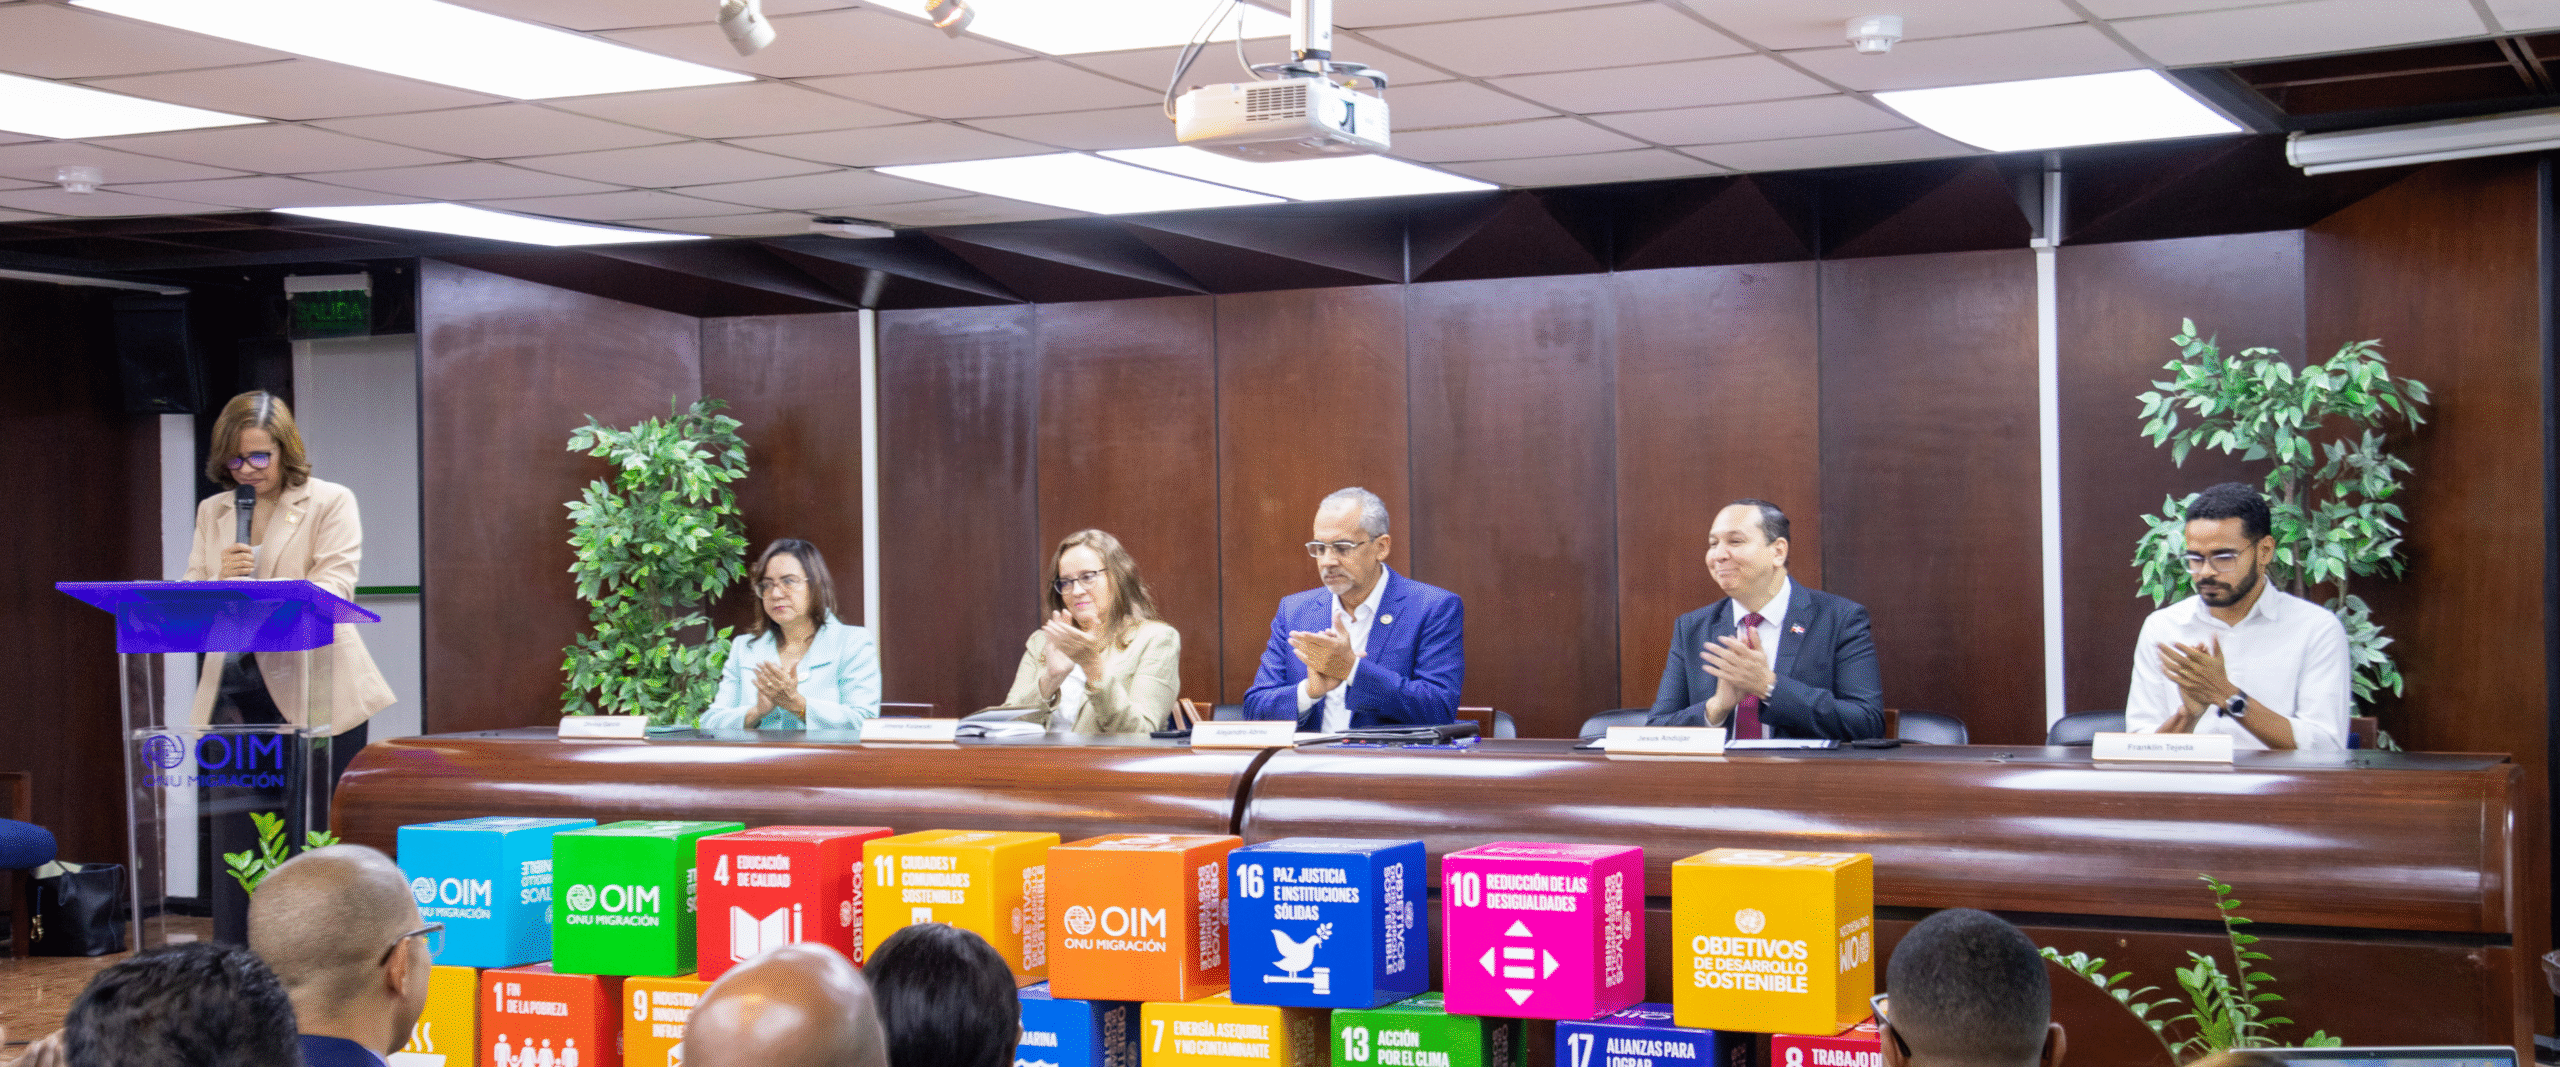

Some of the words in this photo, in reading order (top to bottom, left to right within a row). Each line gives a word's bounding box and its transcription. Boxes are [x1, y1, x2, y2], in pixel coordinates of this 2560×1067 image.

[195, 734, 282, 770] OIM
[2166, 743, 2194, 752] Tejeda
[143, 774, 181, 787] ONU
[187, 771, 284, 788] MIGRACIÓN
[713, 854, 730, 886] 4
[737, 854, 790, 870] EDUCACIÓN
[873, 855, 894, 887] 11
[901, 855, 949, 870] CIUDADES
[950, 856, 957, 871] Y
[737, 872, 750, 887] DE
[750, 872, 791, 888] CALIDAD
[901, 872, 970, 888] COMUNIDADES
[1236, 863, 1264, 898] 16
[1298, 868, 1347, 884] JUSTICIA
[1486, 872, 1549, 891] REDUCCIÓN
[1549, 876, 1564, 892] DE
[1565, 876, 1588, 893] LAS
[439, 877, 492, 907] OIM
[600, 884, 660, 913] OIM
[902, 888, 965, 904] SOSTENIBLES
[1273, 886, 1281, 901] E
[1281, 886, 1360, 903] INSTITUCIONES
[1451, 871, 1480, 908] 10
[418, 906, 435, 918] NU
[435, 906, 492, 920] MIGRACIÓN
[852, 861, 863, 963] OBJETIVOS
[1274, 902, 1319, 921] SÓLIDAS
[1486, 893, 1577, 912] DESIGUALDADES
[566, 914, 594, 925] ONU
[595, 913, 660, 927] MIGRACIÓN
[1022, 866, 1031, 971] OBJETIVOS
[1100, 905, 1166, 938] OIM
[1210, 861, 1221, 968] OBJETIVOS
[1395, 862, 1406, 972] OBJETIVOS
[1615, 871, 1624, 984] OBJETIVOS
[1064, 937, 1094, 950] ONU
[1095, 938, 1166, 953] MIGRACIÓN
[1692, 935, 1808, 960] OBJETIVOS
[1694, 956, 1713, 970] DE
[1715, 957, 1808, 975] DESARROLLO
[506, 982, 521, 997] FIN
[1694, 971, 1808, 993] SOSTENIBLE
[493, 982, 503, 1012] 1
[633, 989, 648, 1021] 9
[506, 999, 518, 1014] DE
[530, 1000, 568, 1017] POBREZA
[1151, 1019, 1165, 1053] 7
[1173, 1020, 1215, 1037] ENERGÍA
[1216, 1023, 1269, 1040] ASEQUIBLE
[1377, 1029, 1420, 1048] ACCIÓN
[1174, 1039, 1182, 1054] Y
[1182, 1039, 1196, 1055] NO
[1196, 1040, 1270, 1059] CONTAMINANTE
[1341, 1026, 1369, 1062] 13
[1567, 1033, 1595, 1067] 17
[1606, 1038, 1663, 1057] ALIANZAS
[1664, 1041, 1696, 1059] PARA
[1377, 1049, 1401, 1065] POR
[1401, 1050, 1415, 1066] EL
[1415, 1051, 1450, 1067] CLIMA
[1785, 1046, 1803, 1067] 8
[1811, 1048, 1870, 1067] TRABAJO
